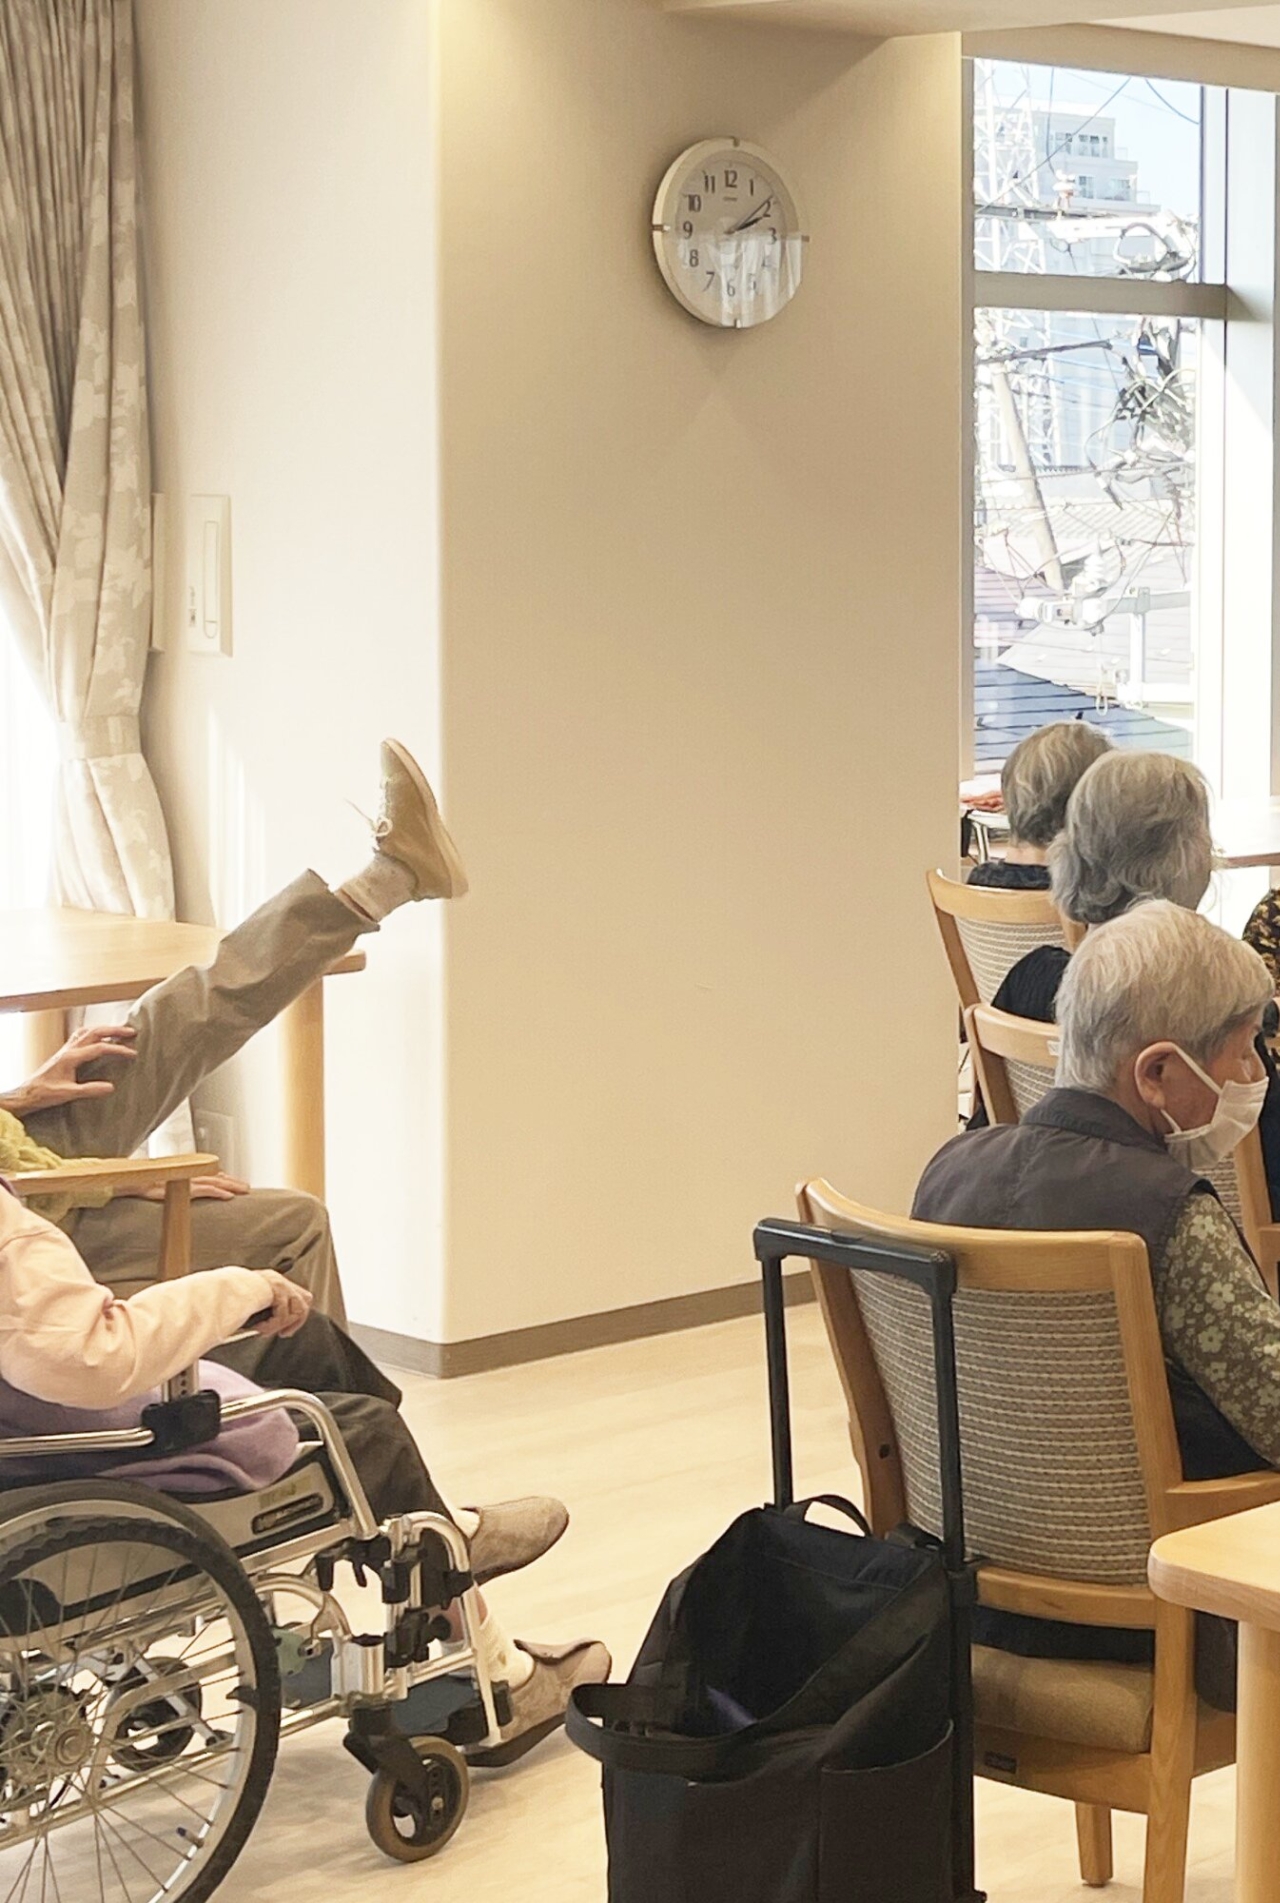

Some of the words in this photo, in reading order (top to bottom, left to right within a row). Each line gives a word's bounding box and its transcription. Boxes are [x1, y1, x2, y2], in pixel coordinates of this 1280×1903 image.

[704, 175, 715, 193] 11
[724, 170, 738, 188] 12
[749, 179, 754, 196] 1
[687, 194, 701, 212] 10
[763, 200, 771, 217] 2
[683, 221, 693, 239] 9
[769, 227, 777, 245] 3
[689, 250, 699, 267] 8
[703, 271, 715, 292] 7
[727, 280, 735, 297] 6
